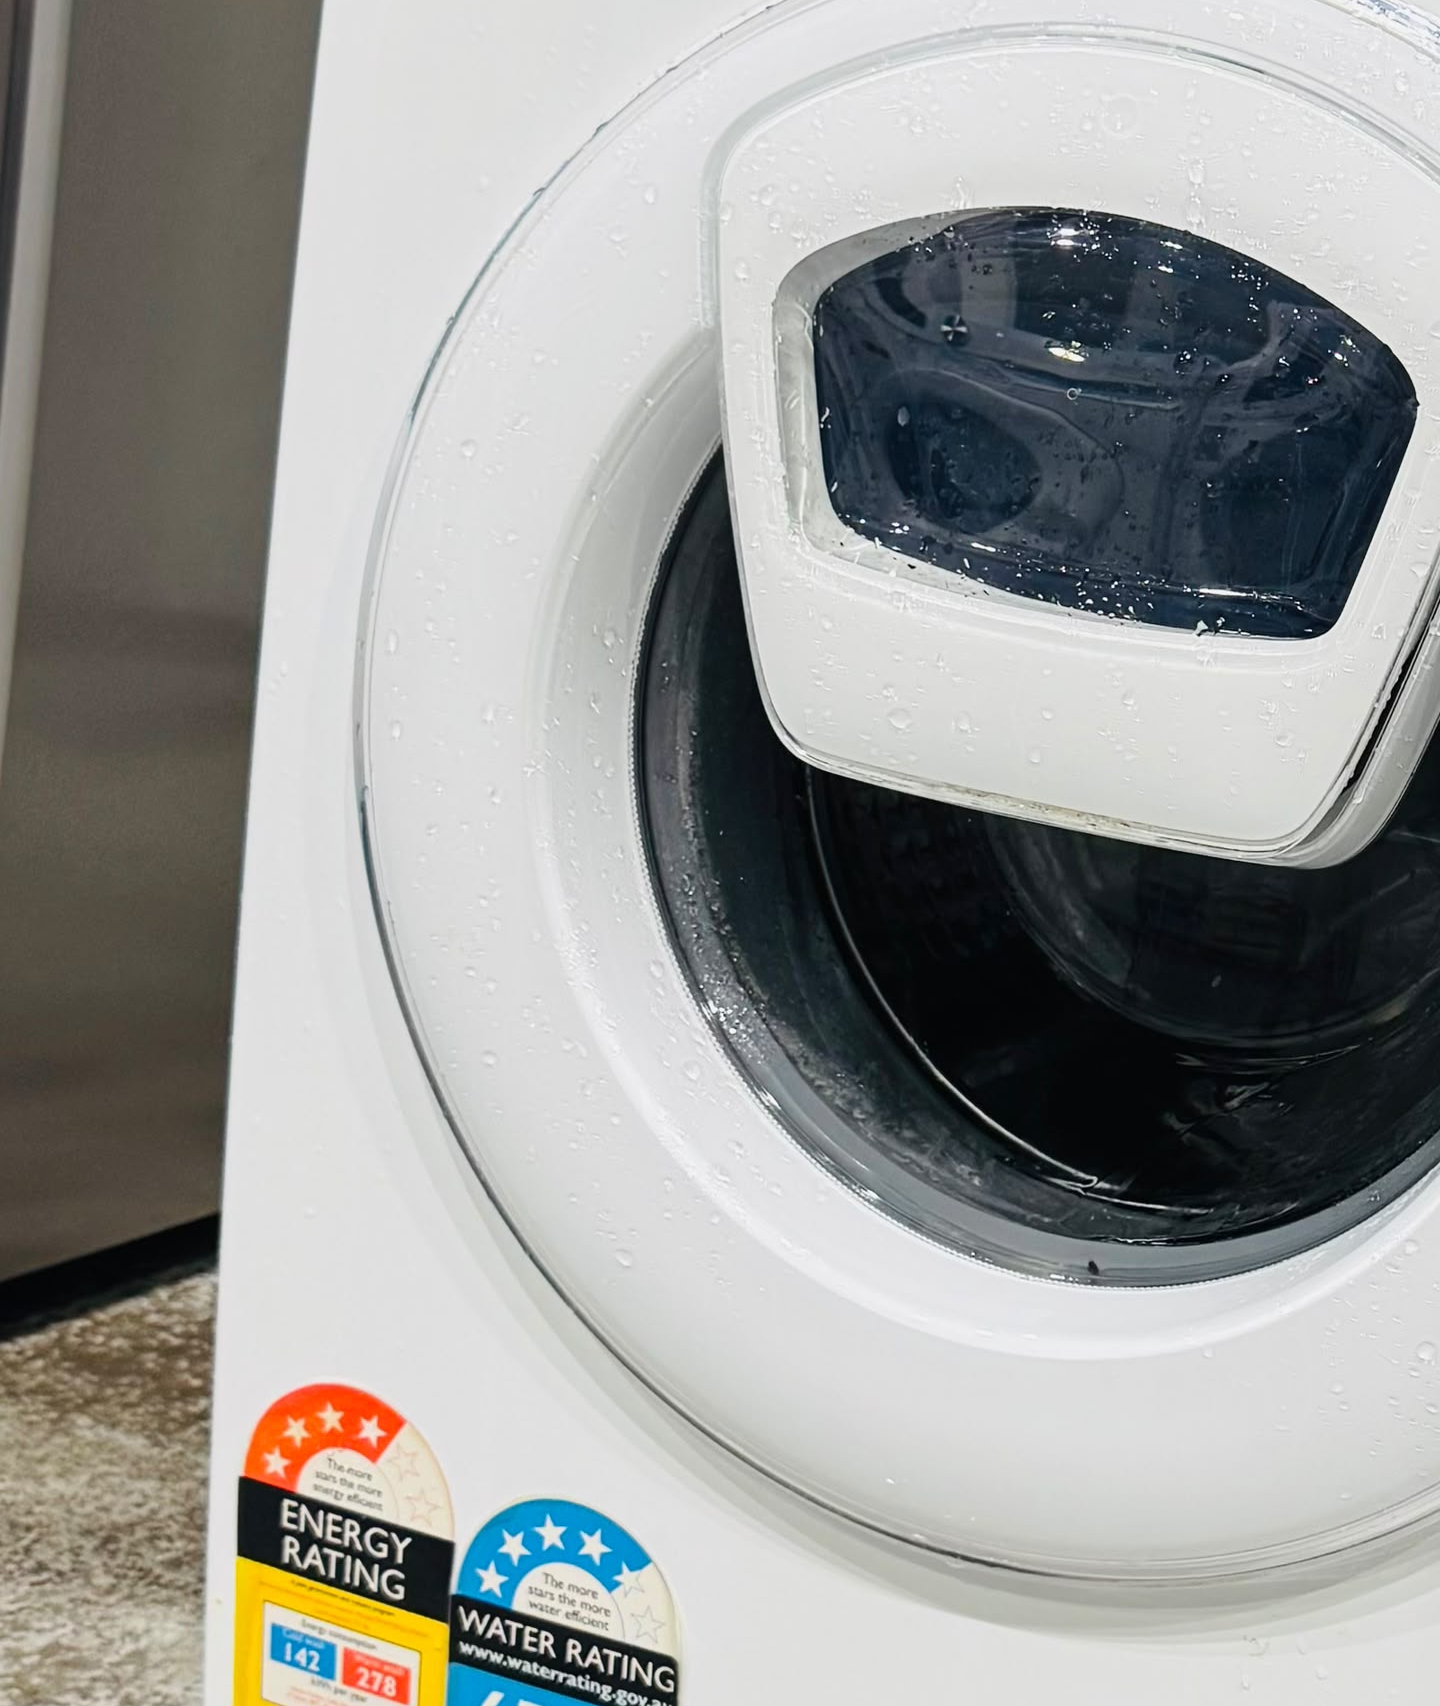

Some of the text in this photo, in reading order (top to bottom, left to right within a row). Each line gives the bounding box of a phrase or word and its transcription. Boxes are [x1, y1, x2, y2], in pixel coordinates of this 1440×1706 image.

[280, 1497, 413, 1564] ENERGY
[281, 1535, 406, 1601] RATING
[542, 1572, 599, 1599] The more
[528, 1586, 611, 1617] stars the more
[529, 1601, 609, 1631] water efficient
[283, 1642, 321, 1672] 142
[458, 1605, 556, 1659] WATER
[565, 1638, 675, 1692] RATING
[356, 1667, 397, 1698] 278
